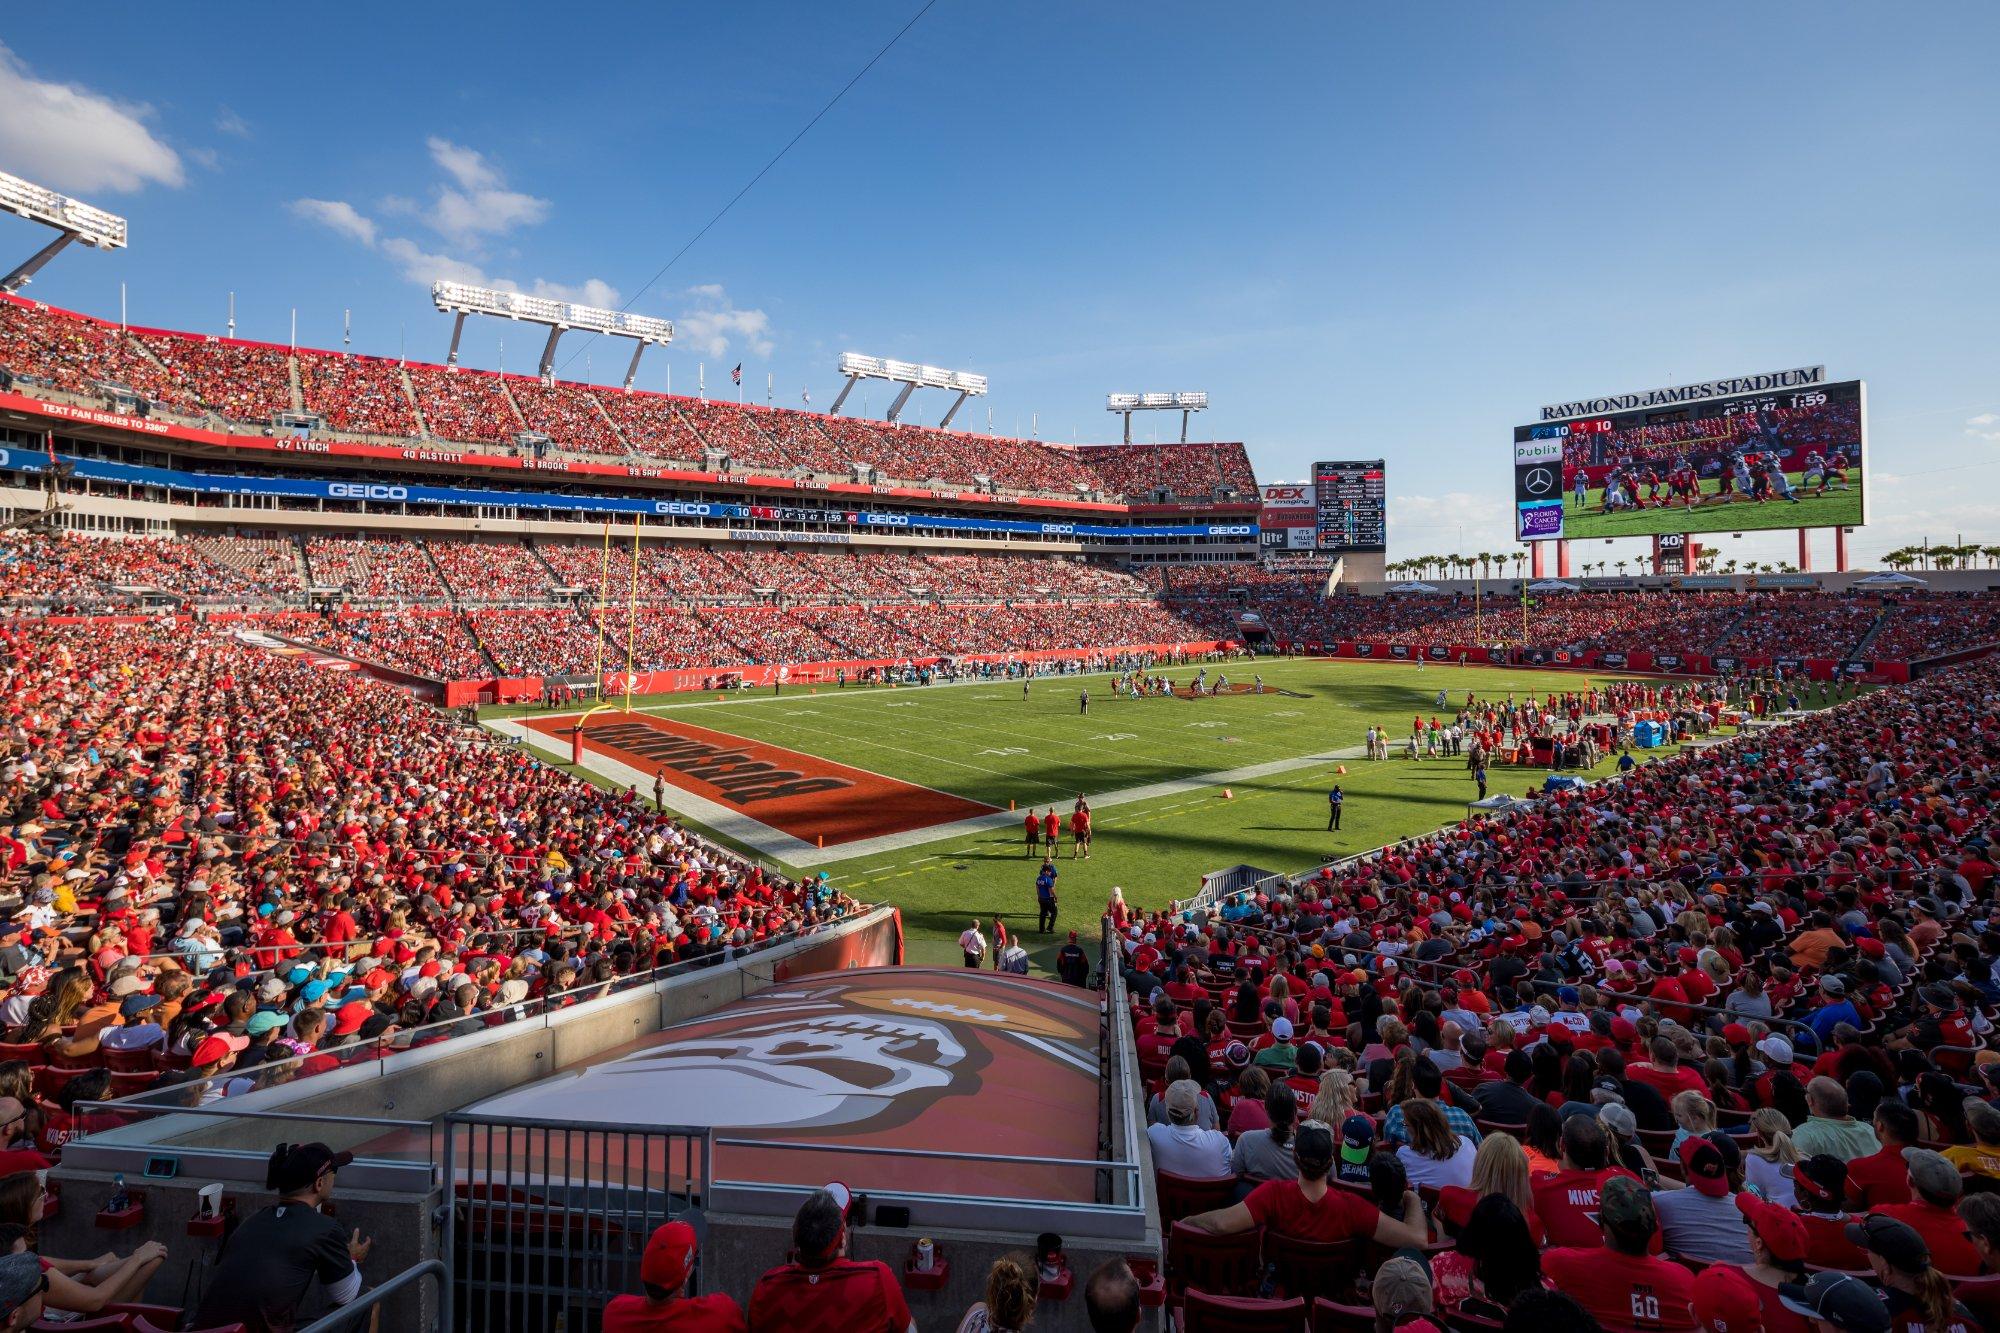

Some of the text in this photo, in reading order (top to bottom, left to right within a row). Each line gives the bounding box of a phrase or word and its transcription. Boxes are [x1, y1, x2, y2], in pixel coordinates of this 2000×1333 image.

[1542, 367, 1821, 420] RAYMOND JAMES STADIUM
[1743, 405, 1757, 414] 13
[1762, 402, 1777, 411] 47
[1790, 393, 1827, 408] 1:59
[42, 403, 69, 416] TEXT
[71, 409, 91, 420] FAN
[94, 413, 129, 427] ISSUES
[131, 419, 143, 429] TO
[1554, 426, 1569, 437] 10
[1596, 420, 1612, 432] 10
[276, 439, 329, 452] 47 LYNCH
[403, 450, 463, 462] 40 ALSTOTT
[523, 459, 569, 470] 55 BROOKS
[642, 469, 661, 477] SAPP
[730, 475, 748, 484] GILES
[328, 483, 408, 500] GEICO
[1265, 488, 1306, 500] DEX
[655, 502, 711, 515] GEICO
[737, 507, 750, 516] 10
[769, 509, 781, 519] 10
[824, 513, 842, 522] 1:59
[867, 514, 909, 525] GEICO
[1534, 516, 1558, 524] CANCER
[1041, 523, 1074, 534] GEICO
[1208, 526, 1250, 535] GEICO
[730, 530, 850, 543] RAYMOND JAMES STADIUM
[1261, 532, 1283, 546] Lite
[1660, 535, 1679, 547] 40
[1556, 652, 1568, 661] 40
[1631, 1293, 1660, 1319] 60
